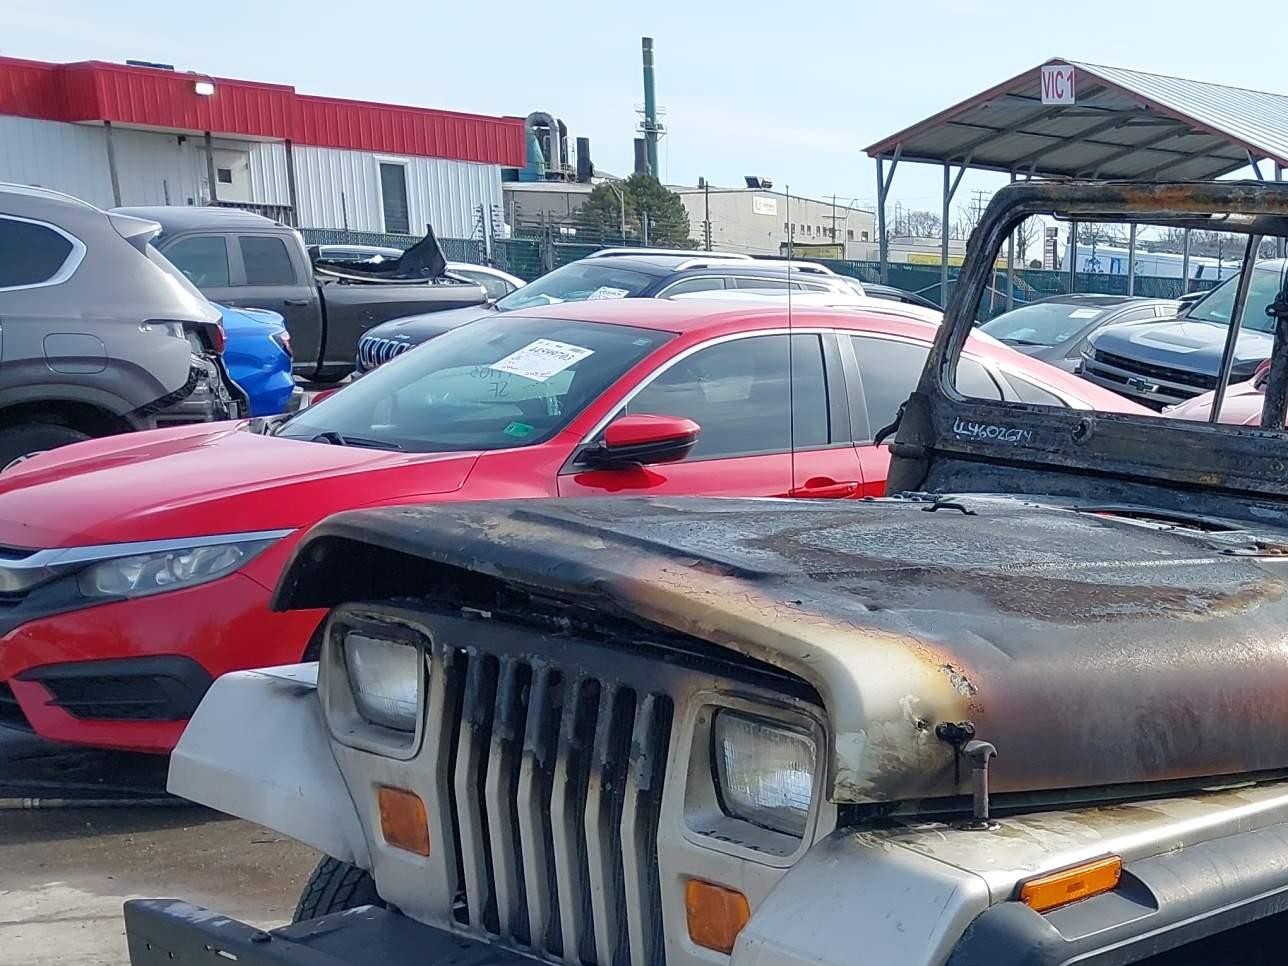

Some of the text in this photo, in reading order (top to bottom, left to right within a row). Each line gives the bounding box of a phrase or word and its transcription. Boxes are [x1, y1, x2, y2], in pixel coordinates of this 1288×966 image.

[1042, 71, 1074, 99] VIC 1
[953, 417, 1032, 441] 44602674
